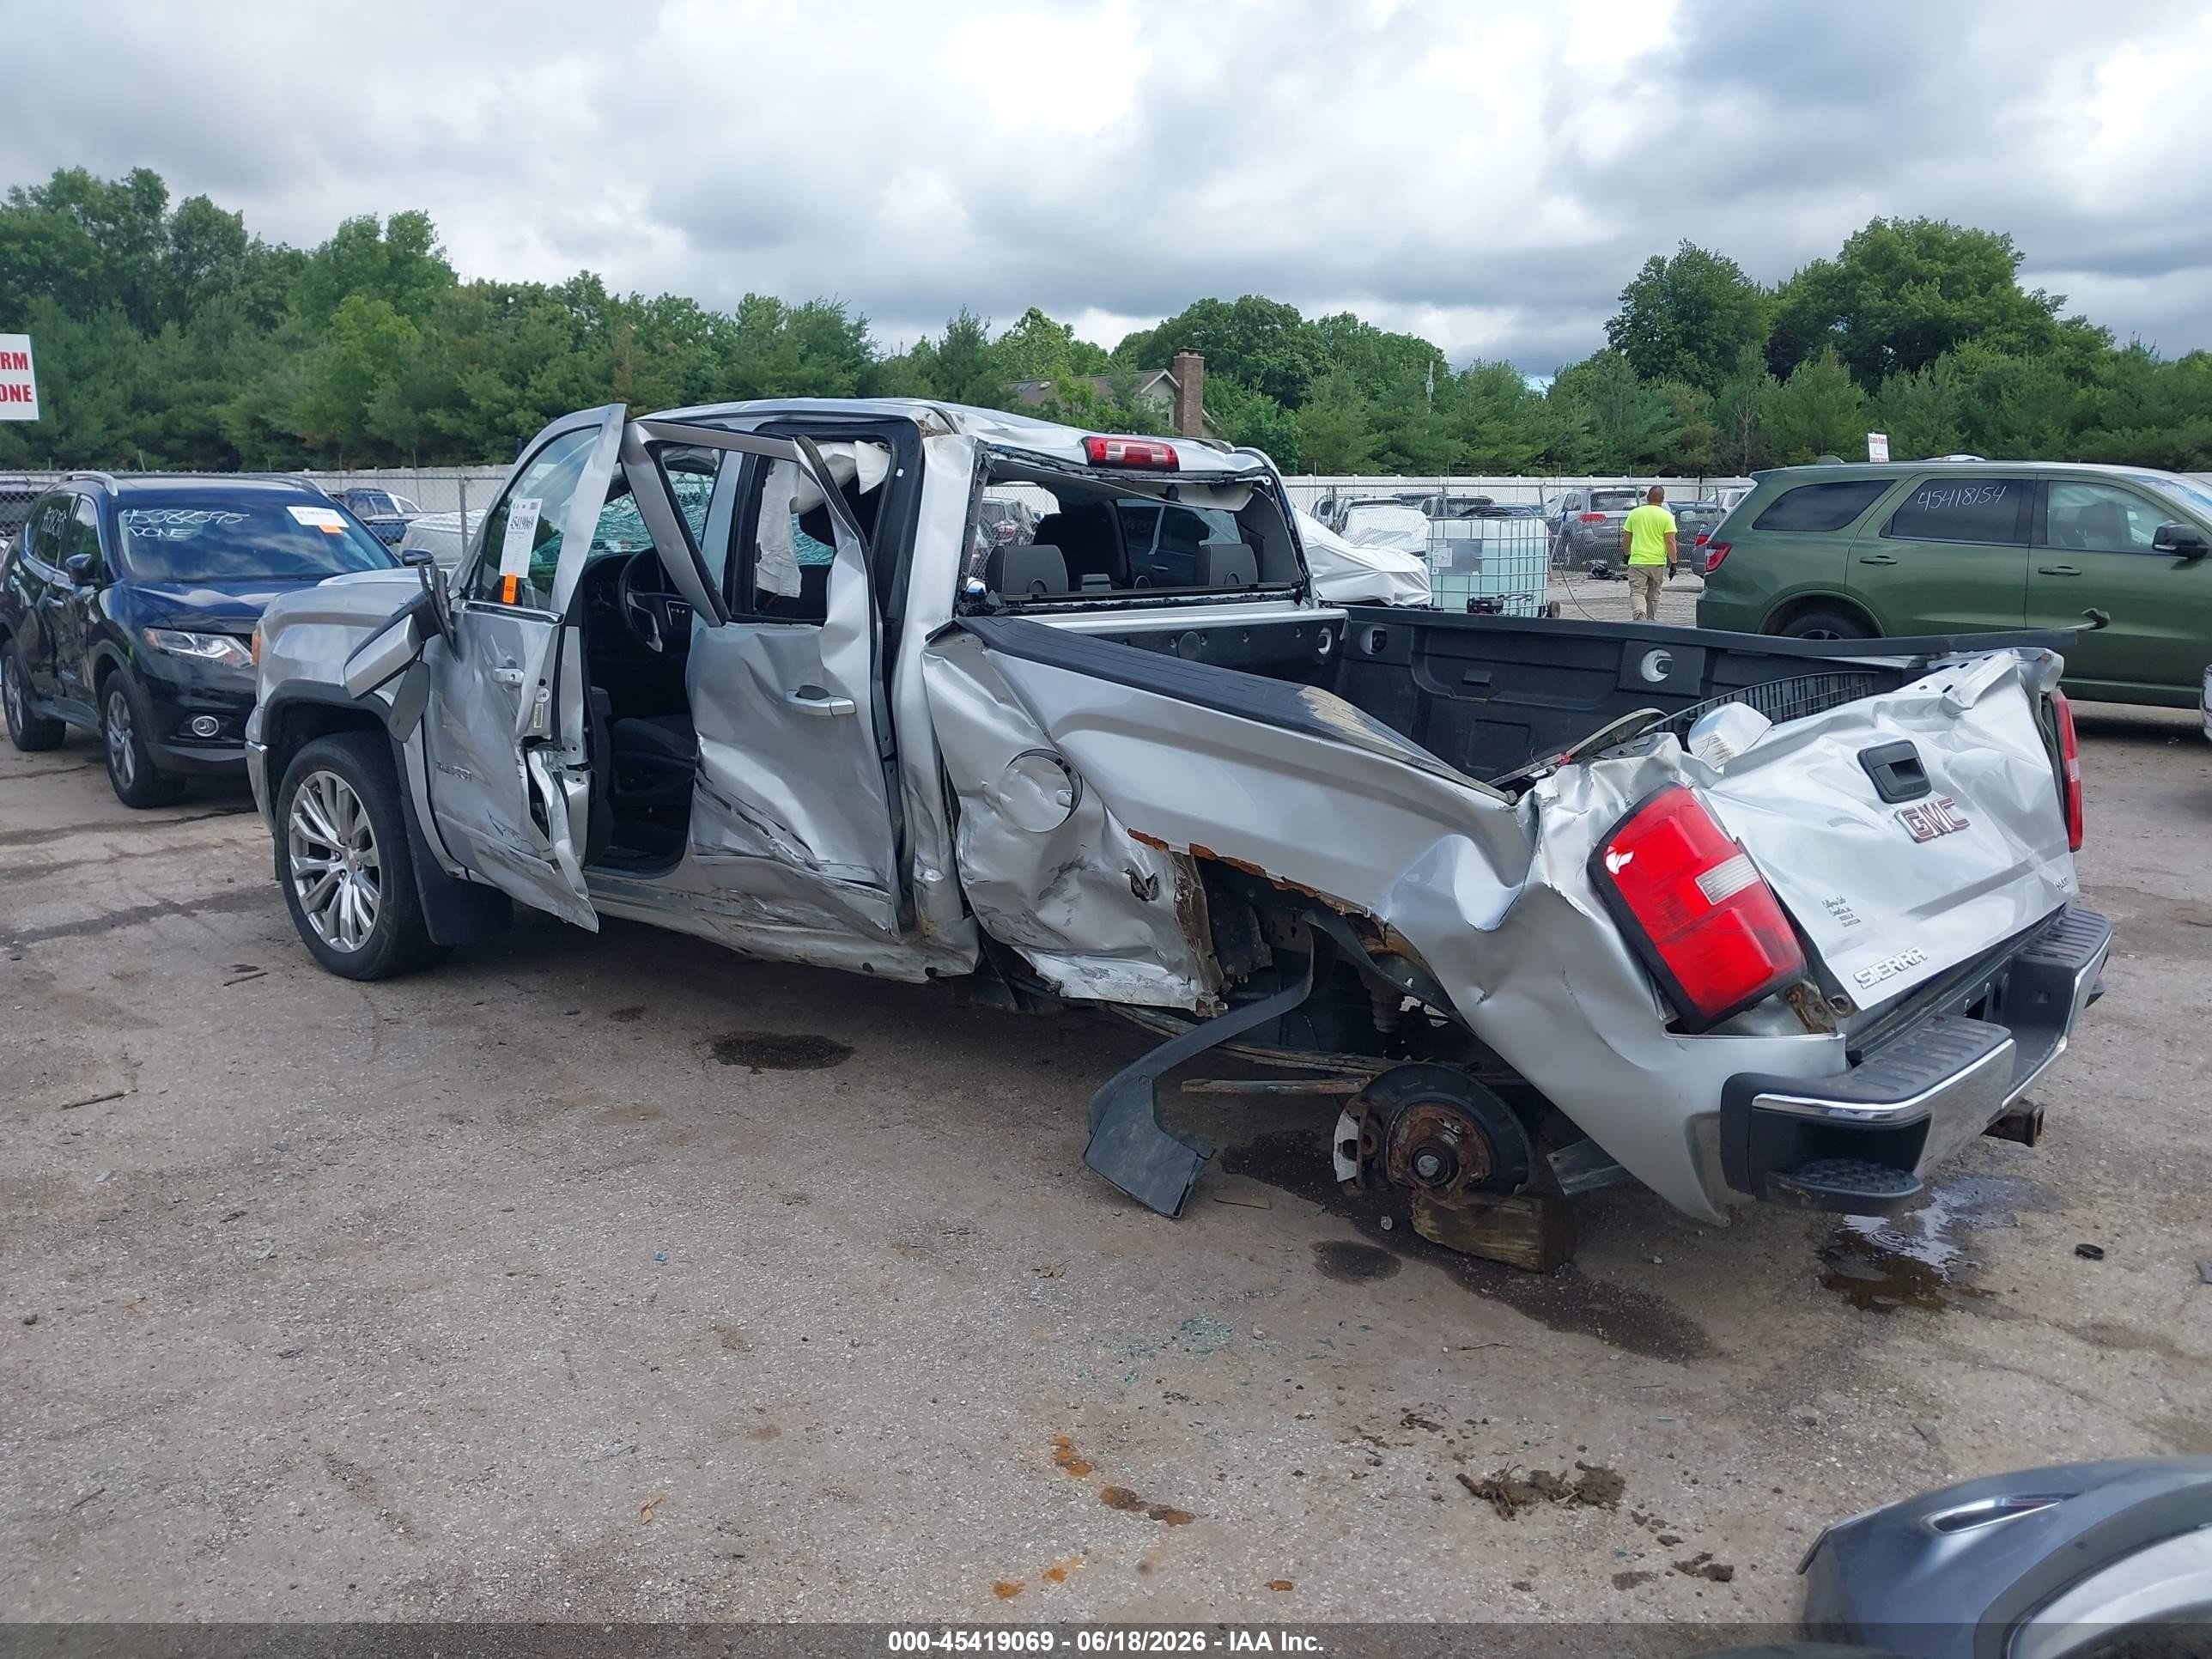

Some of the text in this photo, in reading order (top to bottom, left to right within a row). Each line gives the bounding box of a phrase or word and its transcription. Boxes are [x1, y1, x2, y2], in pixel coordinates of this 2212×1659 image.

[0, 352, 28, 371] RM
[1917, 485, 2007, 512] 45418154
[127, 526, 194, 540] DONE
[510, 516, 534, 530] 45419069
[1894, 797, 1972, 843] GMC
[1853, 946, 1929, 989] SIERRA
